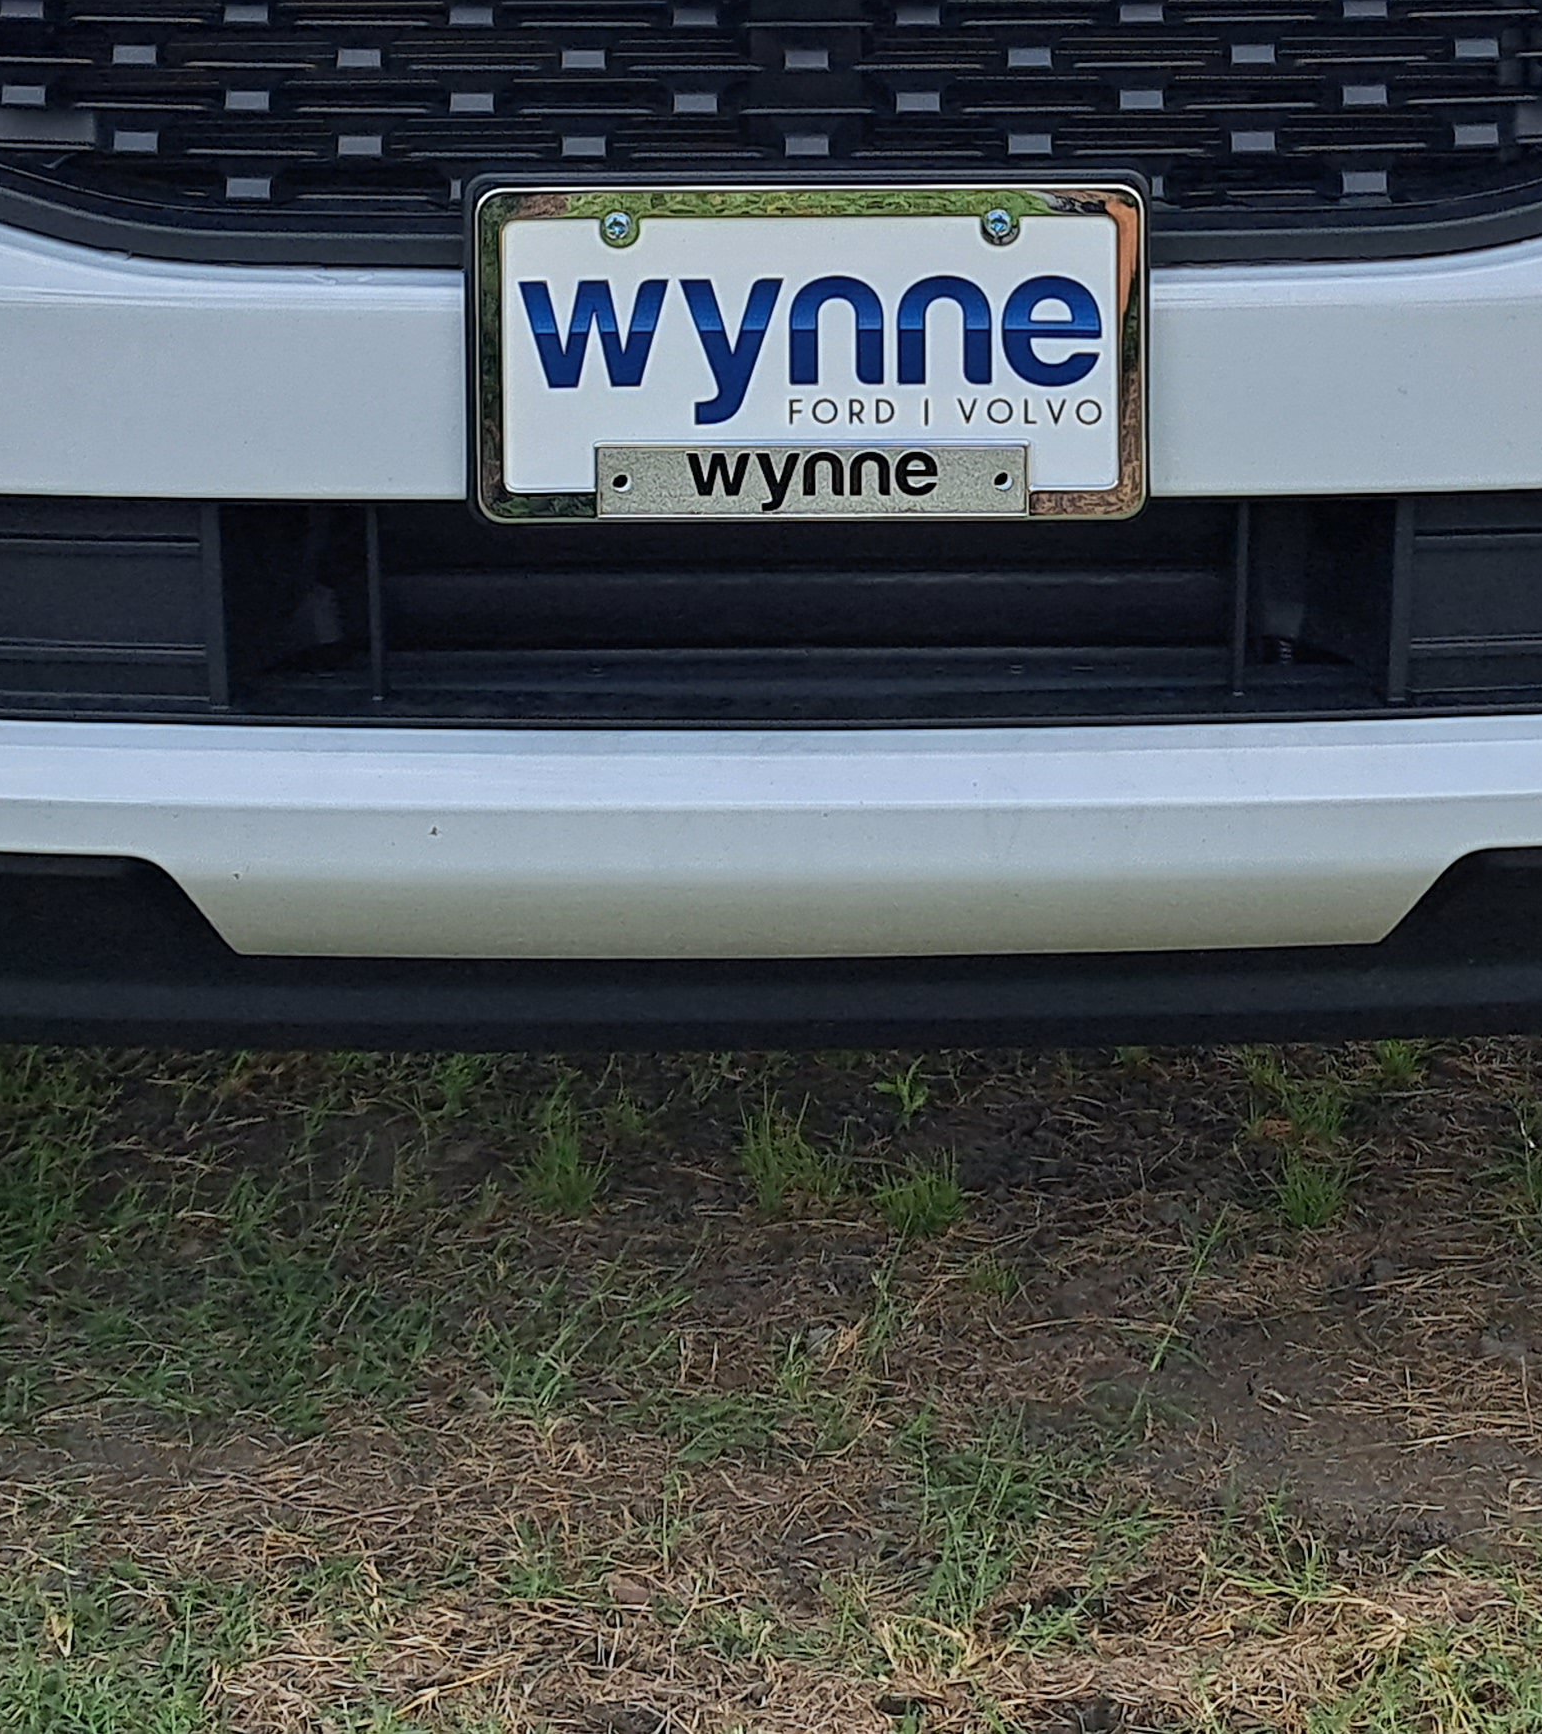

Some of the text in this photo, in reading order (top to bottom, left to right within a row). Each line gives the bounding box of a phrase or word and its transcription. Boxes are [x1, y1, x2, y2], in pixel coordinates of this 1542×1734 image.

[517, 275, 1104, 426] wynne
[788, 397, 896, 426] FORD
[956, 397, 1104, 426] VOLVO
[686, 451, 939, 512] wynne
